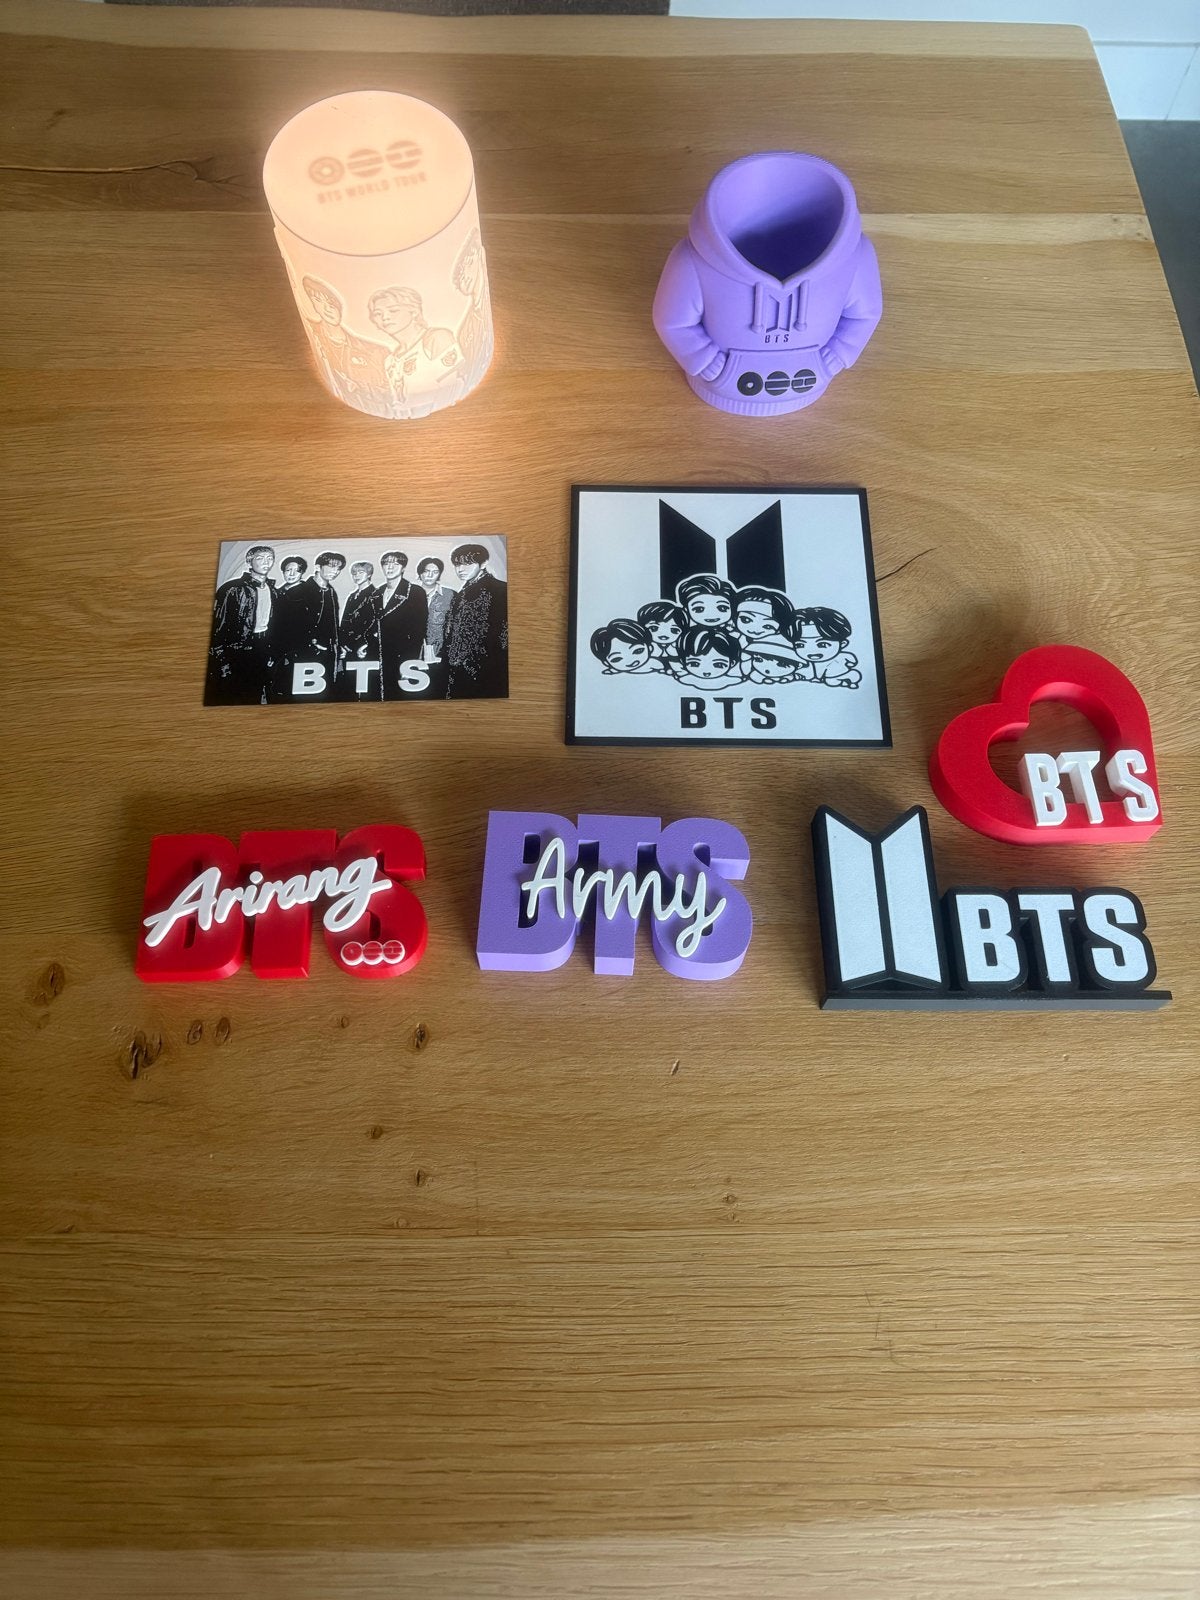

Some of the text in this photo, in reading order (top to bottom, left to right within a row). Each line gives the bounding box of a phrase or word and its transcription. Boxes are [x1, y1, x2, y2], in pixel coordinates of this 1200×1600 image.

[345, 179, 390, 197] WORLD
[394, 171, 427, 188] TOUR
[764, 333, 790, 344] BTS
[291, 659, 432, 696] BTS
[680, 696, 778, 730] BTS
[1021, 749, 1159, 827] BTS
[135, 824, 428, 983] BTS
[144, 856, 392, 947] Arirang
[476, 810, 753, 981] BTS
[522, 837, 727, 958] Army
[955, 893, 1149, 983] BTS
